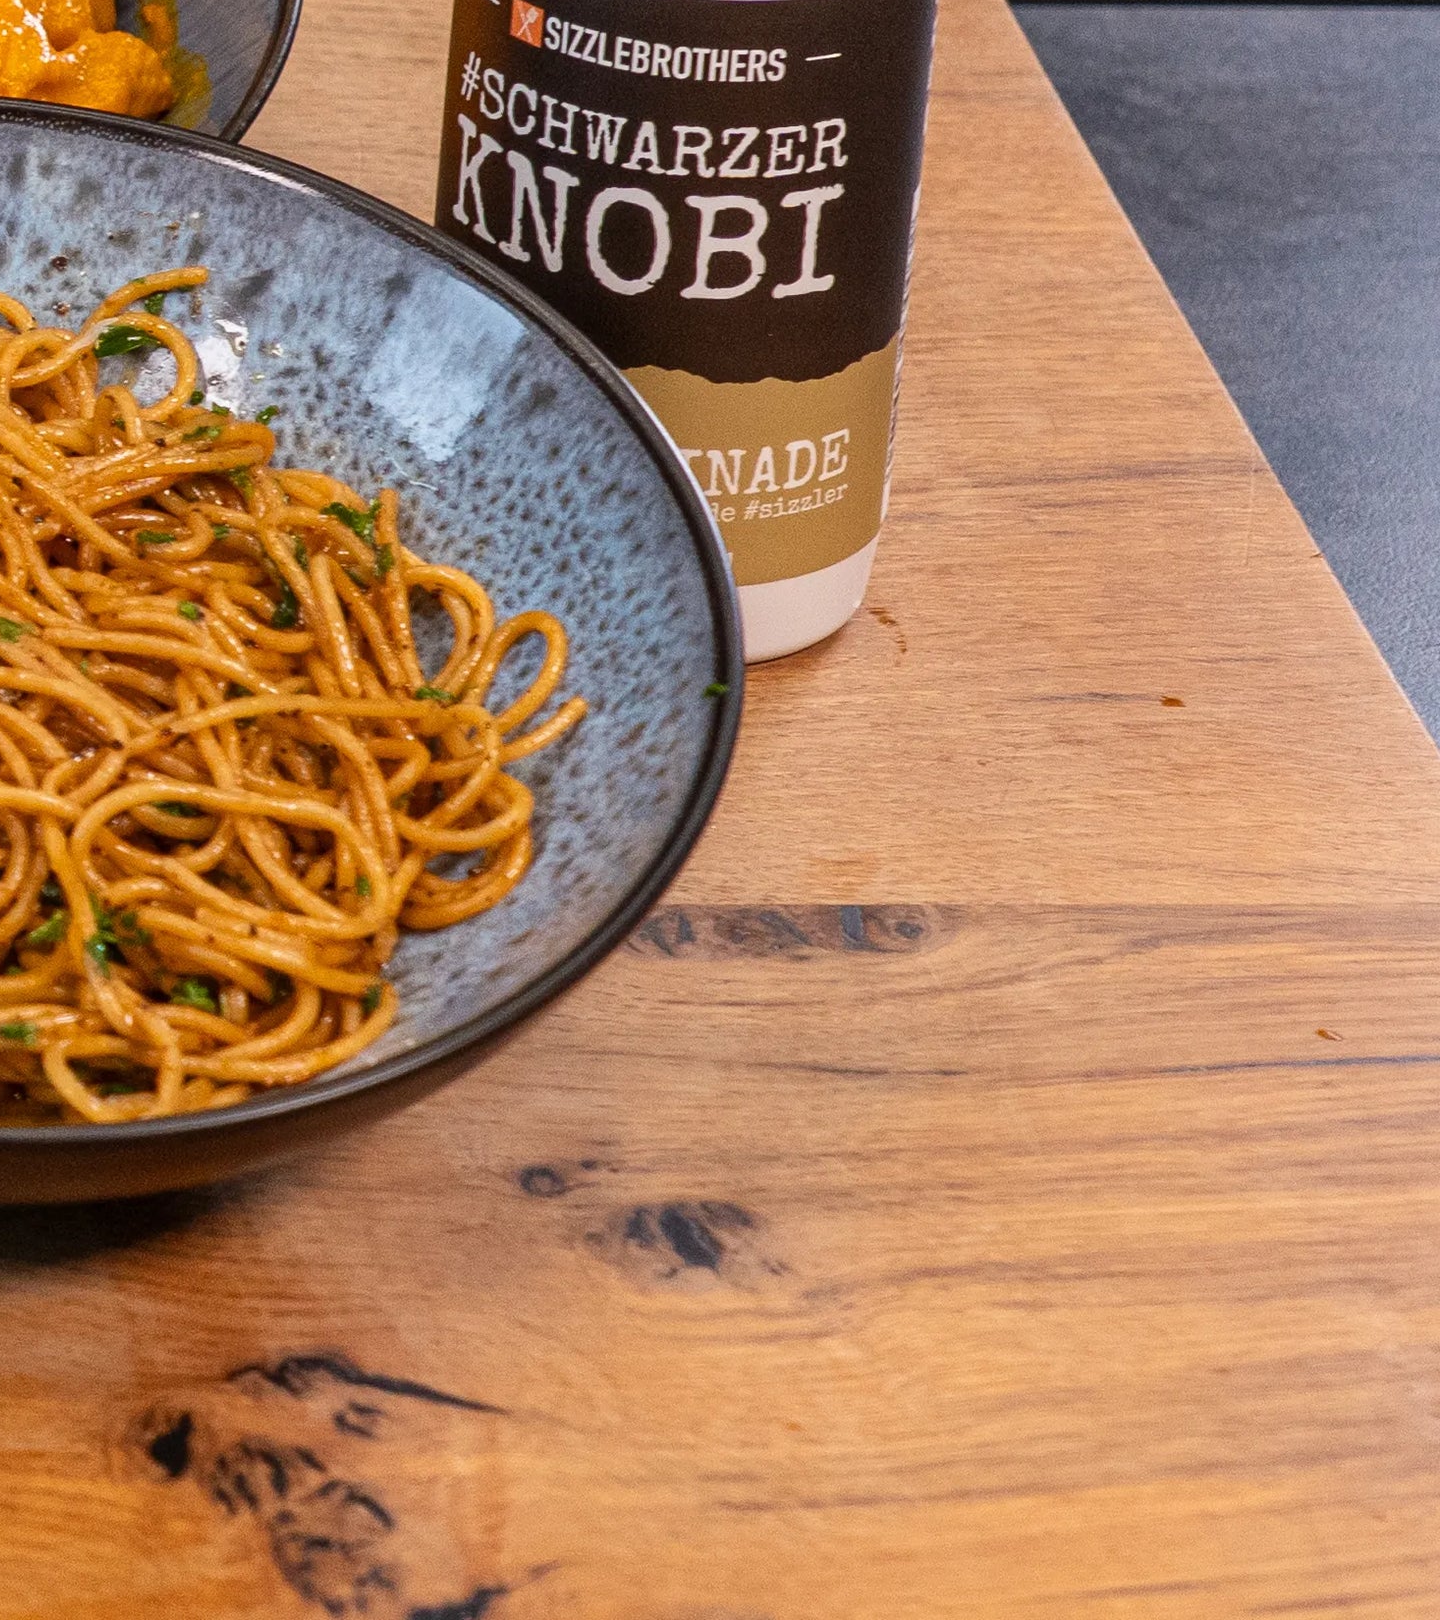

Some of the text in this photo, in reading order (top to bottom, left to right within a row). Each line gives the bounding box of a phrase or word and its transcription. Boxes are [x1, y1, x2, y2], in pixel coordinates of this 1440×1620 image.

[545, 16, 787, 83] SIZZLEBROTHERS
[461, 51, 849, 179] #SCHWARZER
[452, 114, 845, 300] KNOBI
[743, 483, 849, 521] #sizzler
